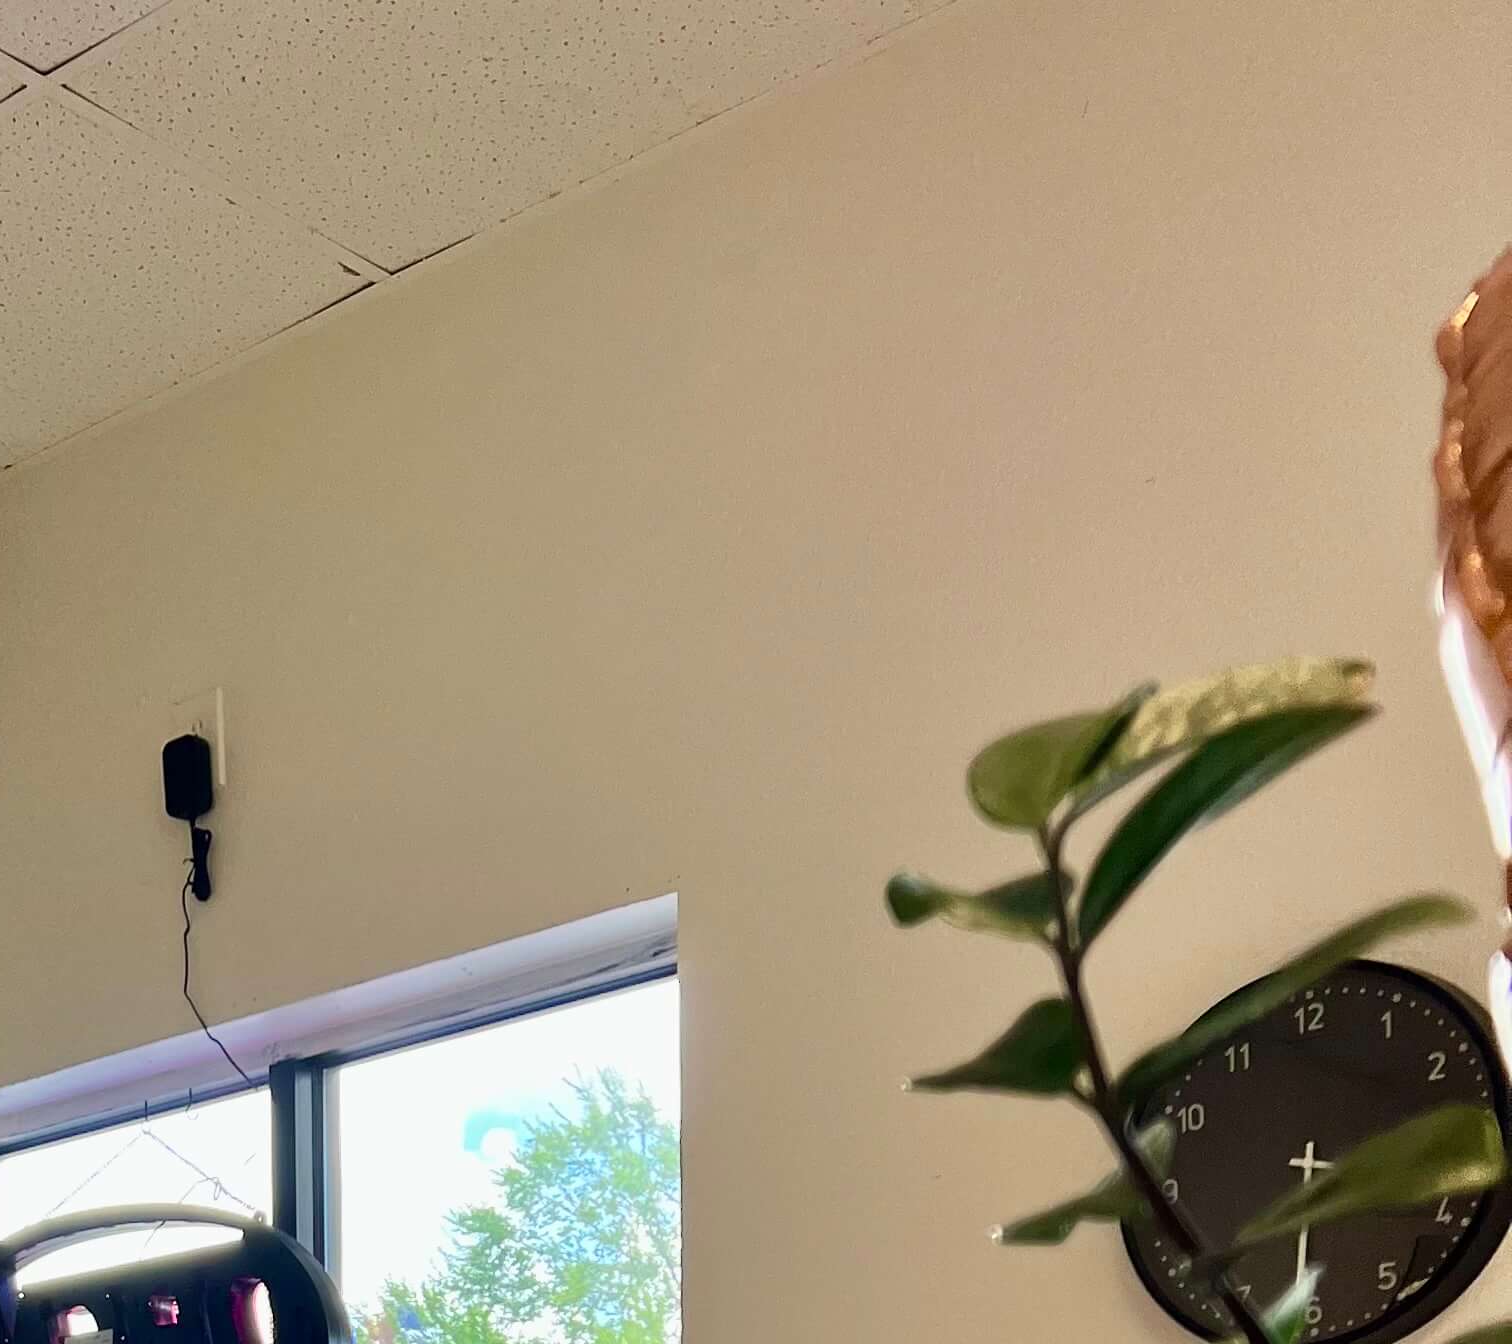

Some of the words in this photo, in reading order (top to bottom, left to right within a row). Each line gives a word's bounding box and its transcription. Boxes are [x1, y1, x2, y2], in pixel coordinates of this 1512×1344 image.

[1294, 1003, 1324, 1035] 12
[1380, 1011, 1393, 1039] 1
[1225, 1042, 1249, 1073] 11
[1428, 1052, 1446, 1081] 2
[1177, 1103, 1205, 1133] 10
[1162, 1178, 1179, 1204] 9
[1434, 1197, 1454, 1225] 4
[1377, 1261, 1397, 1290] 5
